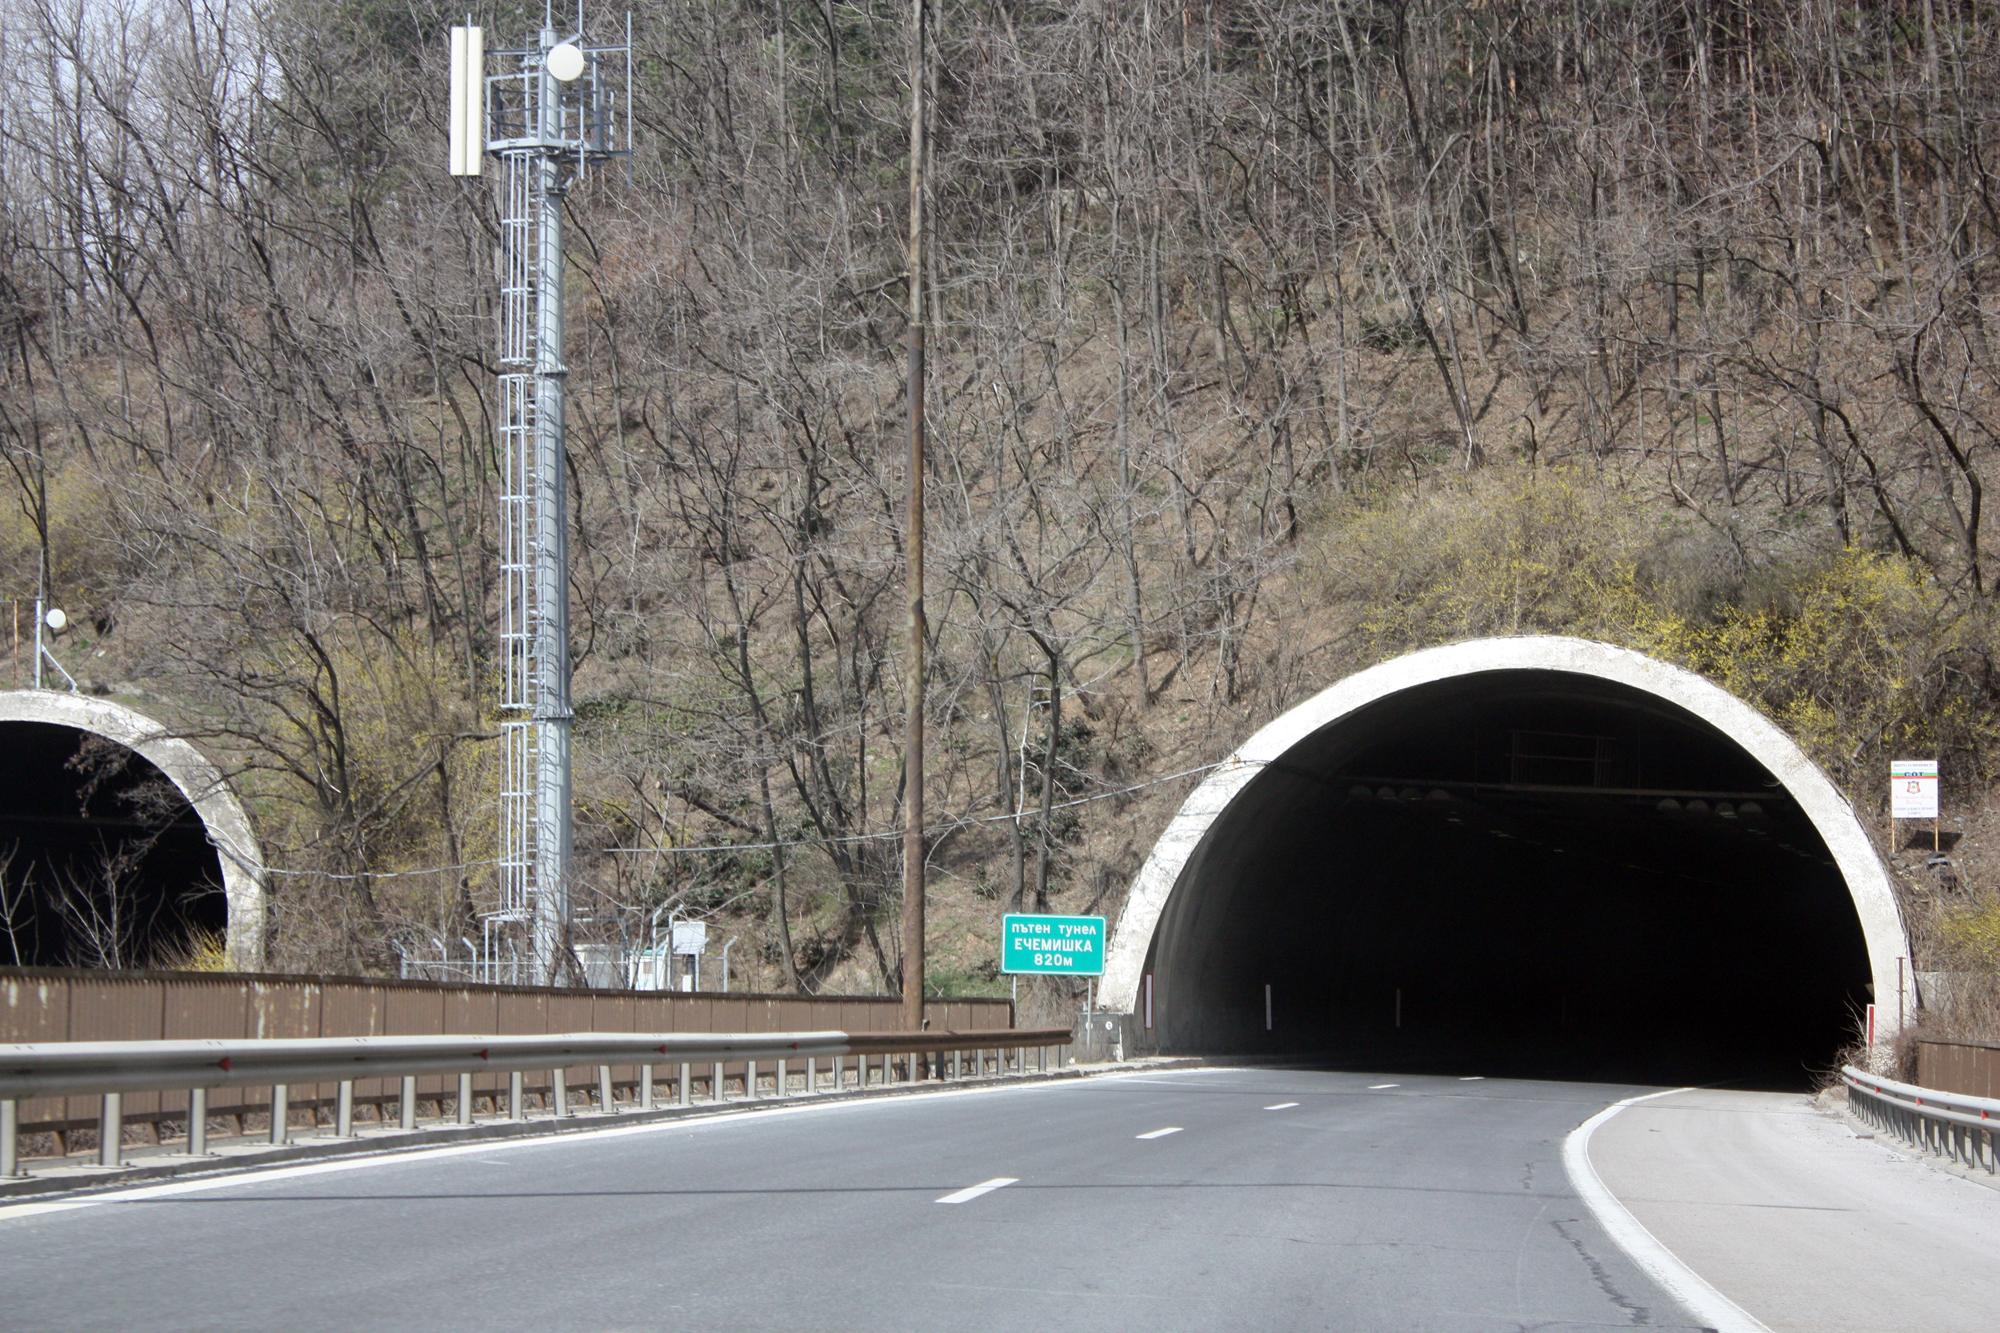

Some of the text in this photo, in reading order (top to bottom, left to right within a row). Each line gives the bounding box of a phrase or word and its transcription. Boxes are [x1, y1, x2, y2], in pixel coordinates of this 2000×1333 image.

[1011, 923, 1097, 937] пътен тунел
[1014, 937, 1093, 952] ЕЧЕМИШКА
[1034, 953, 1073, 966] 820м
